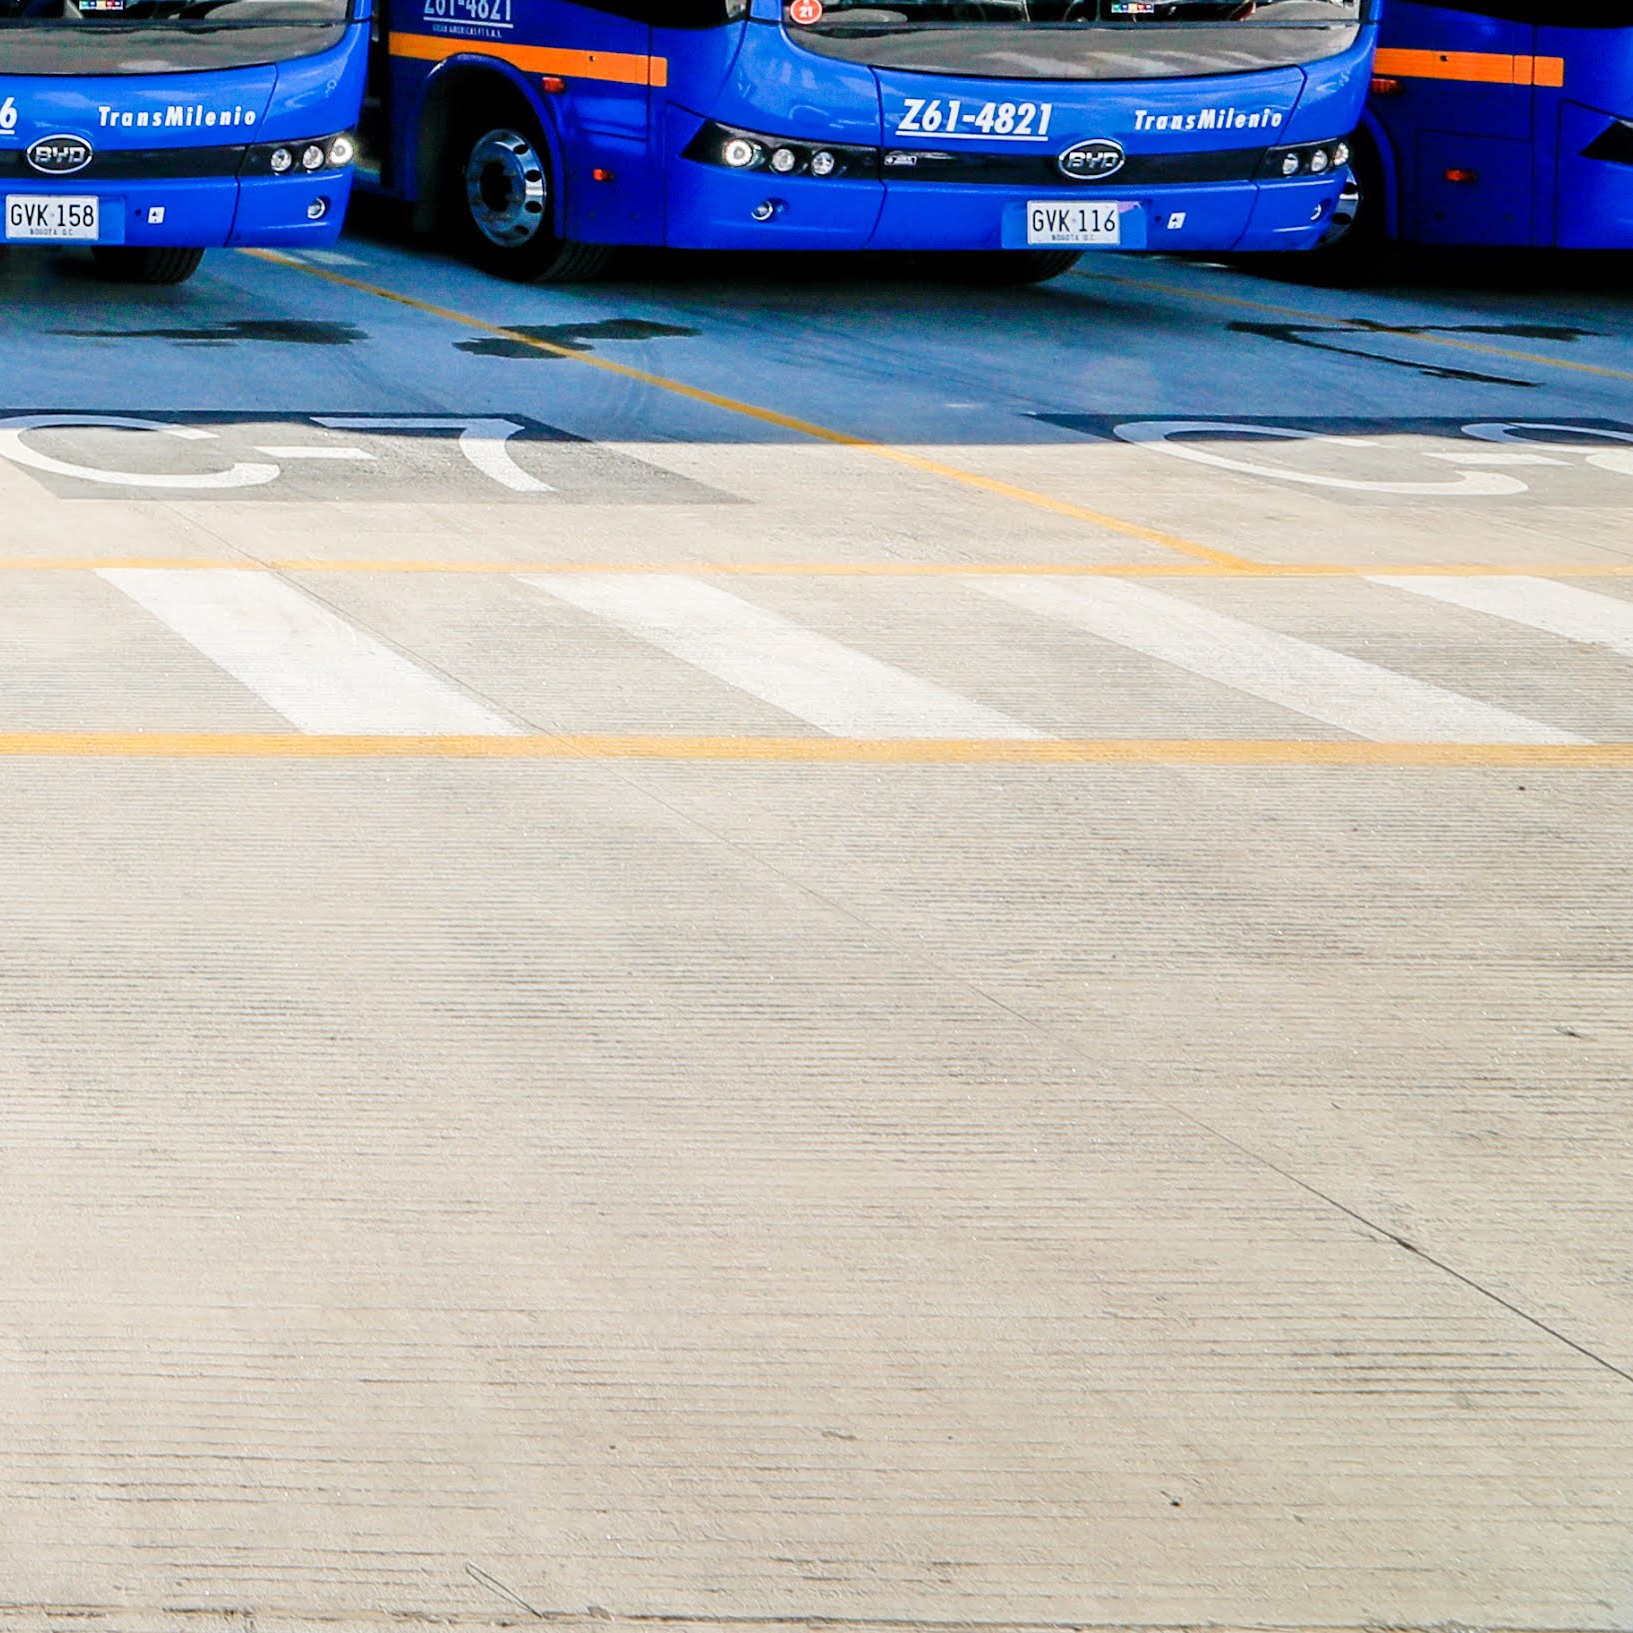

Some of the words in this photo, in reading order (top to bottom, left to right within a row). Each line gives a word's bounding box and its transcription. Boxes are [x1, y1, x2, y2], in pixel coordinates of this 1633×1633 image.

[98, 103, 258, 129] TransMilenio
[898, 98, 1053, 136] Z61-4821
[1133, 107, 1283, 131] TransMilenio
[34, 146, 87, 164] BYD
[1066, 151, 1120, 169] BYD
